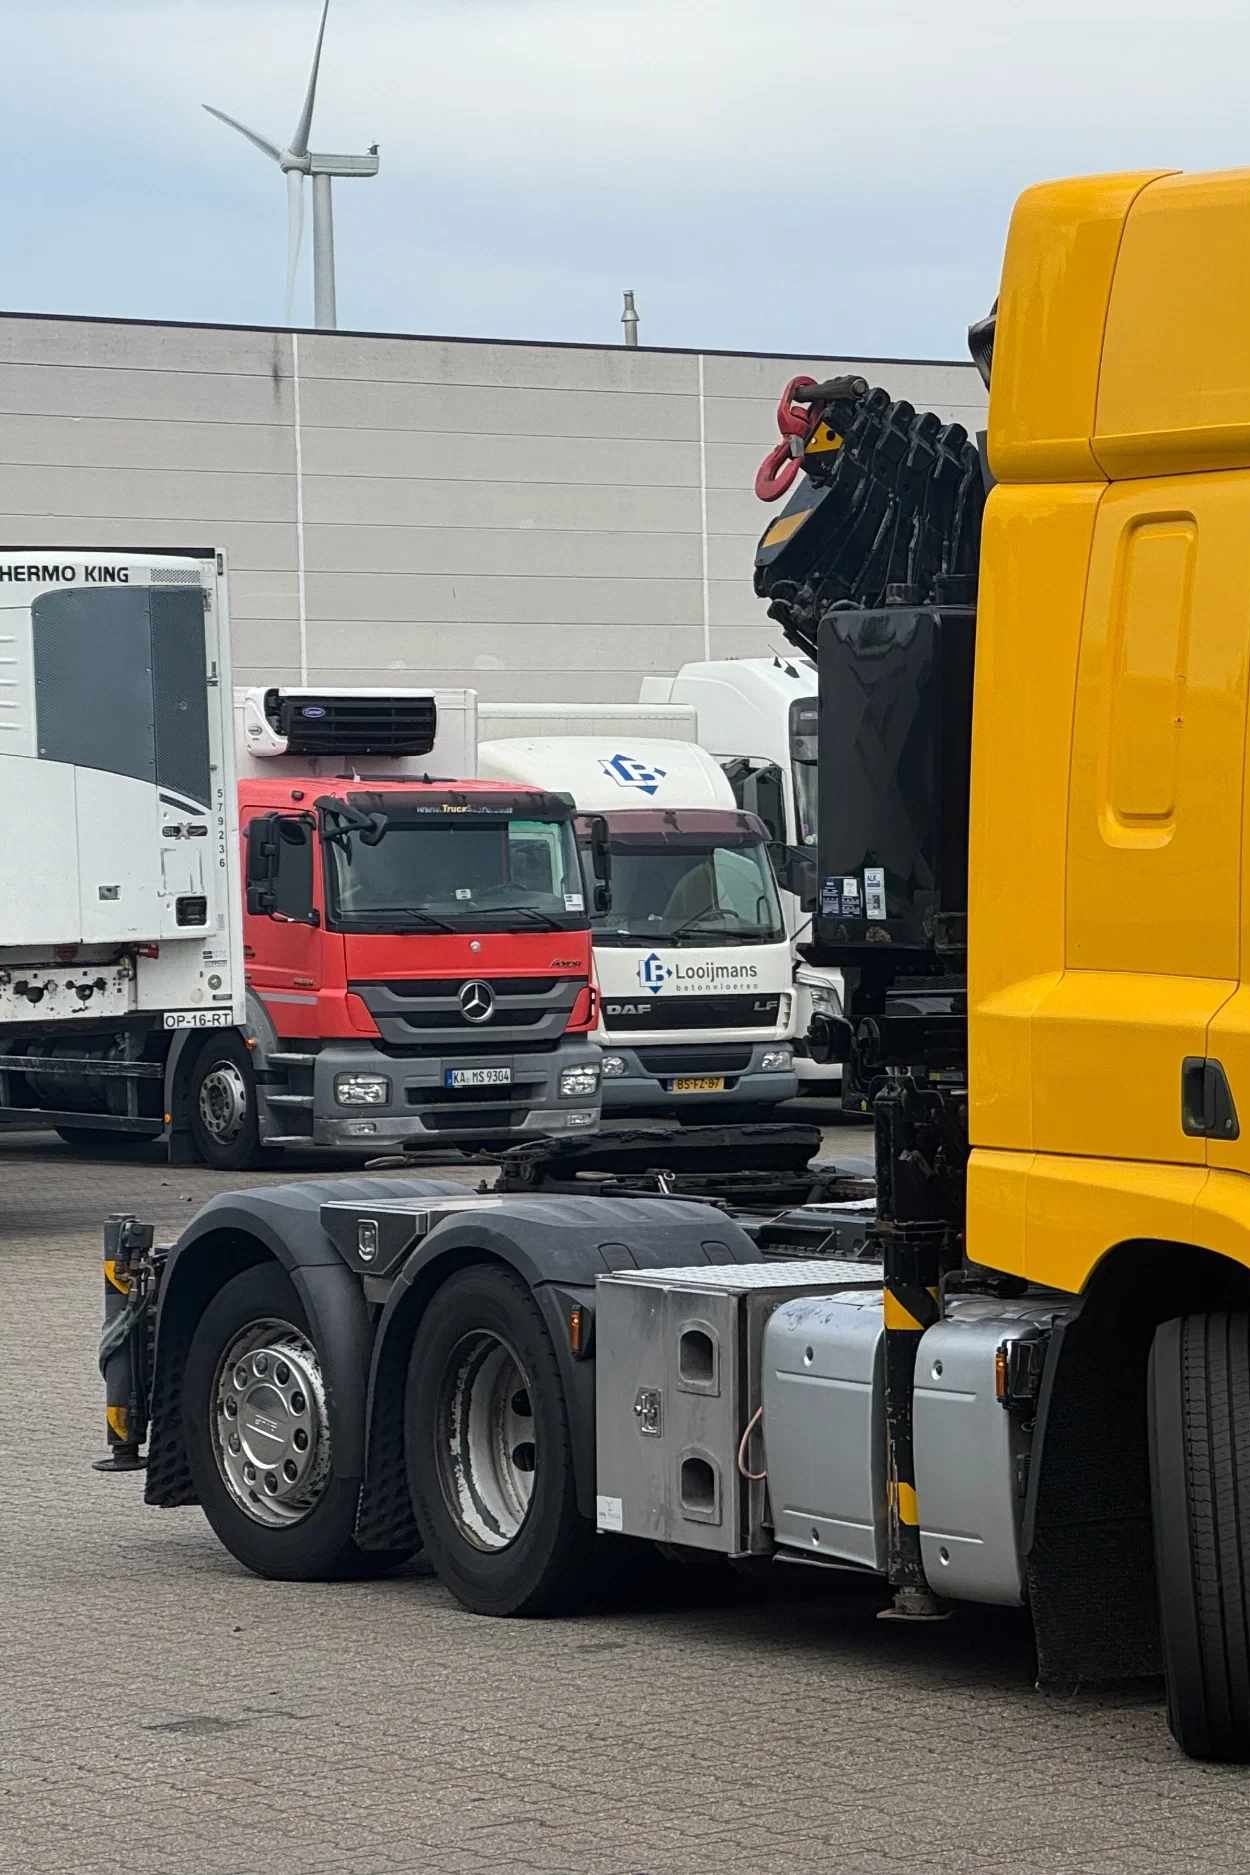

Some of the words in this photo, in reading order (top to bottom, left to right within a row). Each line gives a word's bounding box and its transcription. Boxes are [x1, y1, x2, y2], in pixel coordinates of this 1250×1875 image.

[84, 565, 129, 583] KING
[675, 962, 758, 982] Looijmans
[676, 983, 759, 992] betonvloeren
[606, 1004, 651, 1015] DAF
[753, 1001, 778, 1011] LF
[165, 1013, 231, 1028] OP-16-RT
[453, 1071, 466, 1084] KA
[472, 1070, 485, 1083] MS
[486, 1068, 509, 1083] 9304
